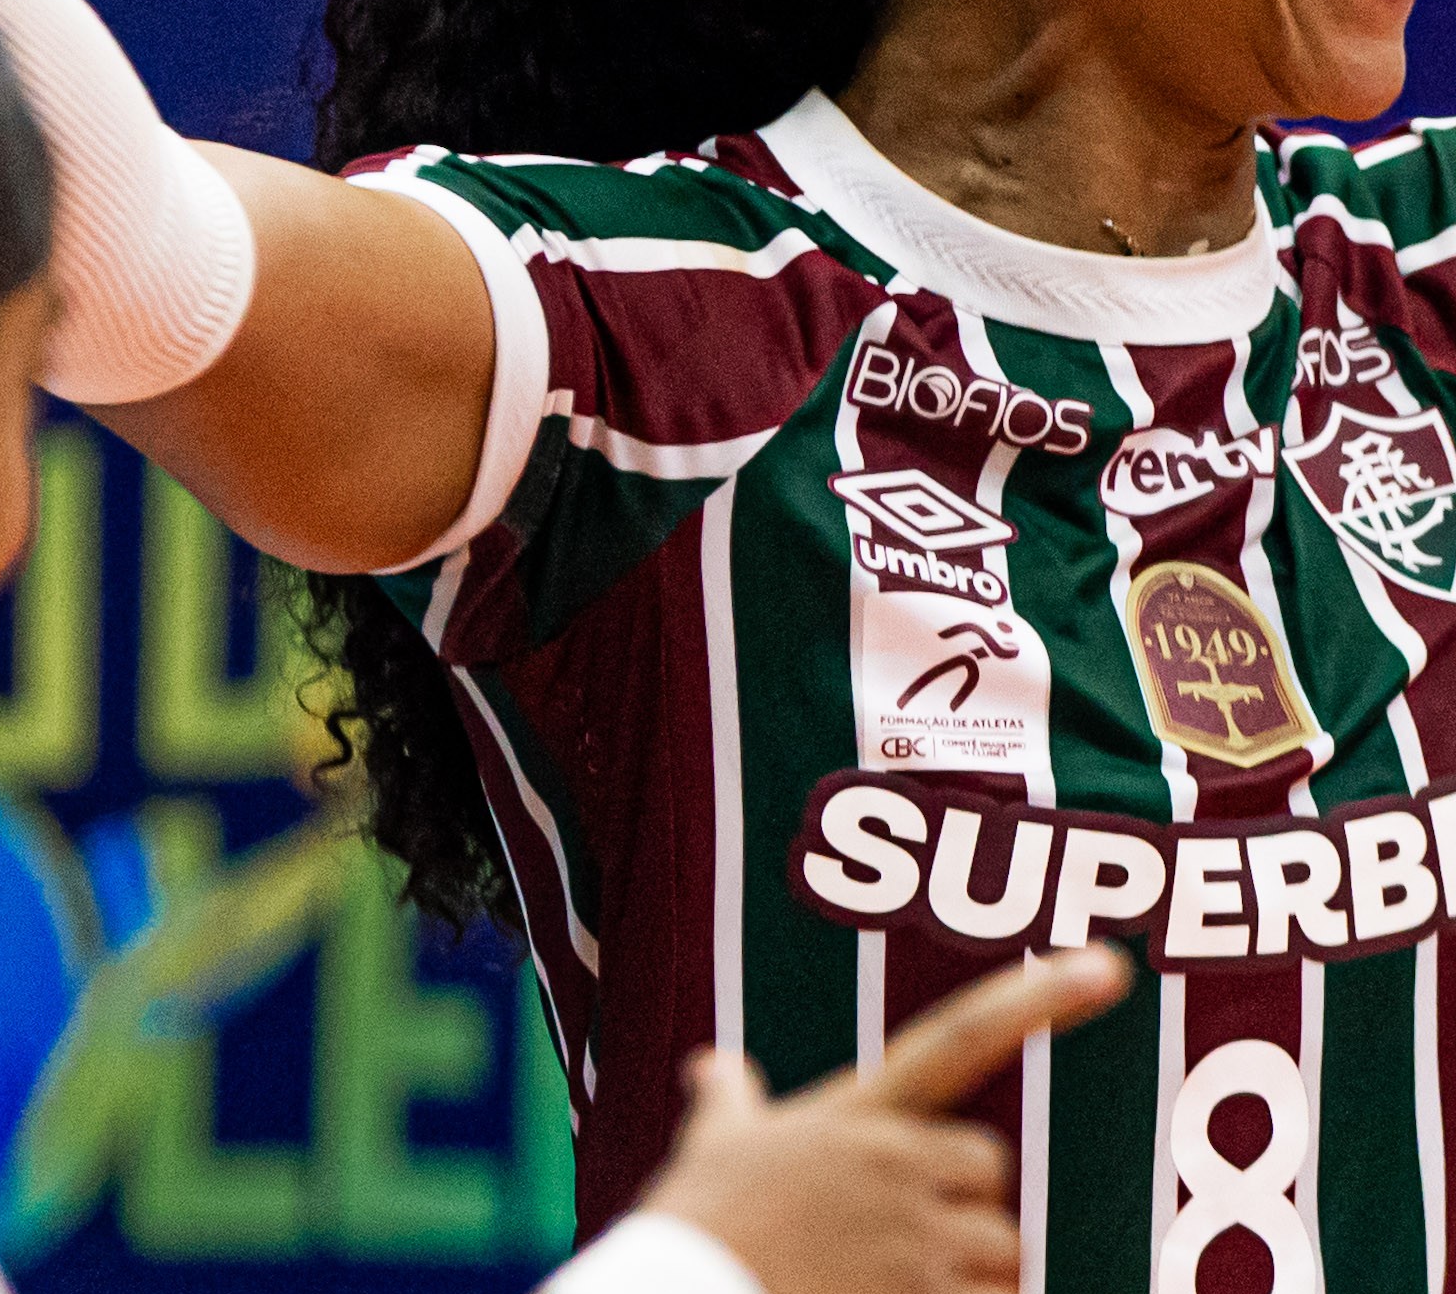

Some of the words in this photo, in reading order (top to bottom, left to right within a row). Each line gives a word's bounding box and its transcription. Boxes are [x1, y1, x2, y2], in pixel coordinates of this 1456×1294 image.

[852, 344, 1091, 455] BIOFIOS
[858, 538, 1003, 601] umbro
[1154, 621, 1258, 666] 1949
[953, 718, 968, 730] DE
[972, 718, 1025, 731] ATLETAS
